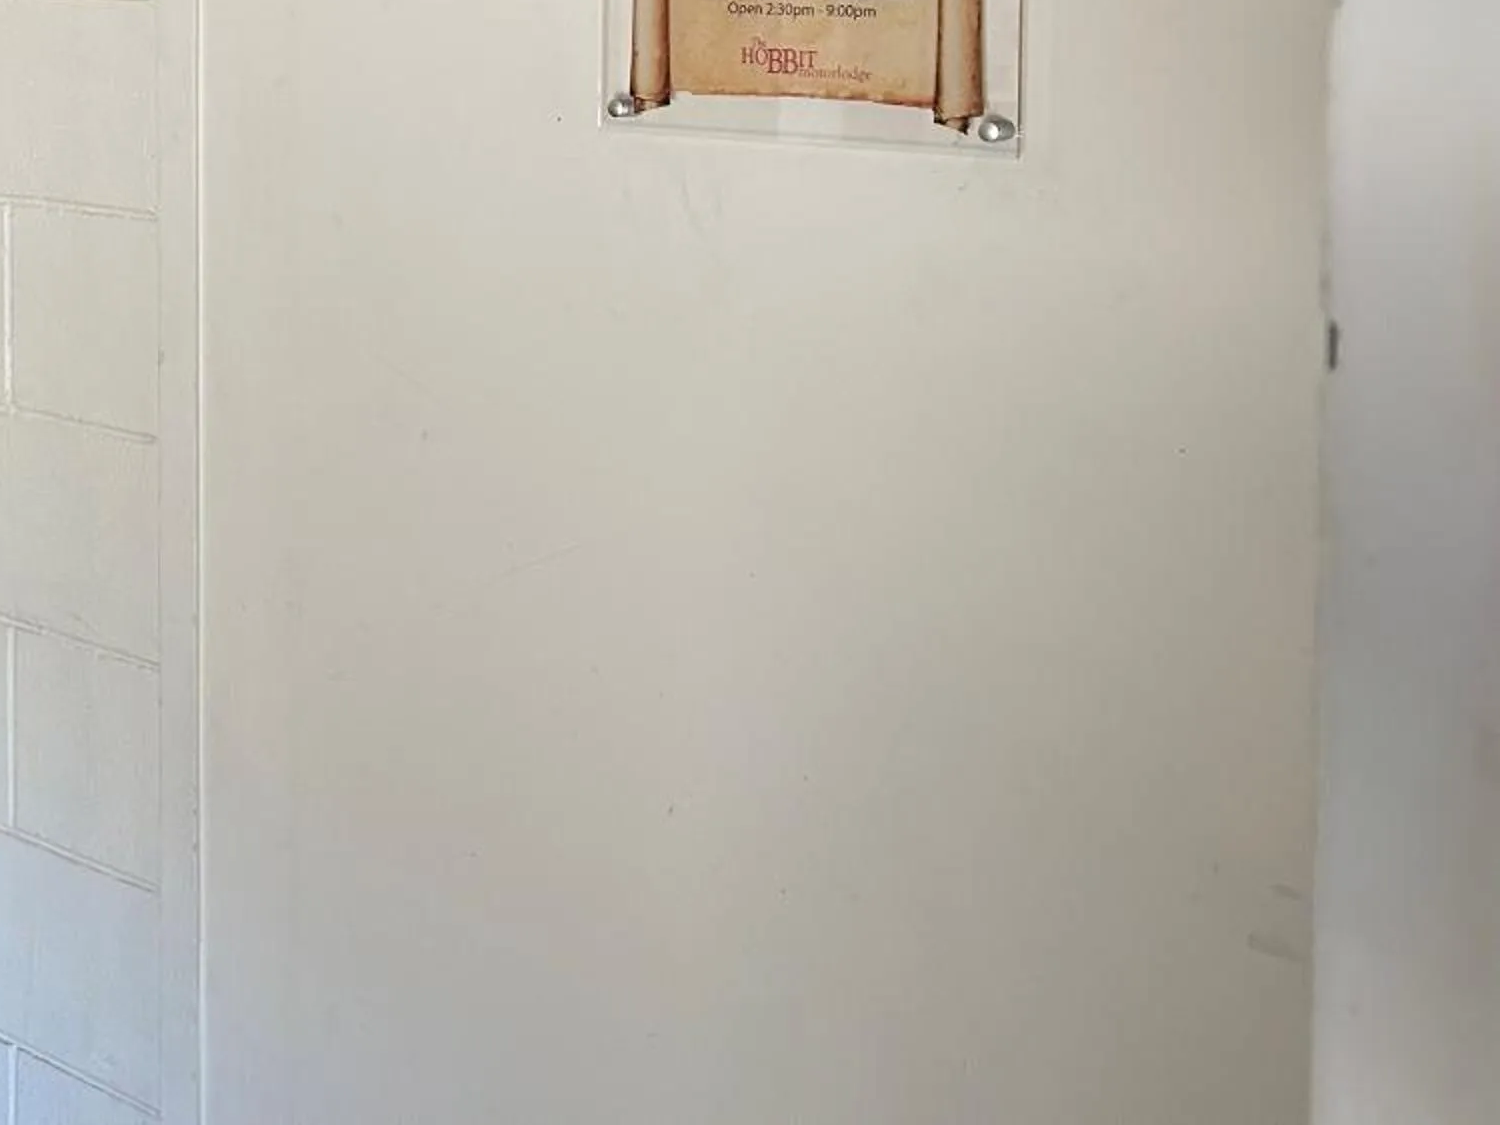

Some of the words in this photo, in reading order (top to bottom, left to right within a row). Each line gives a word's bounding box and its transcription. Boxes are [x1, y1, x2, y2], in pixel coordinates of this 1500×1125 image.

[727, 1, 763, 17] Open
[766, 2, 815, 18] 2:30pm
[826, 3, 877, 19] 9:00pm
[740, 46, 819, 74] HOBBIT
